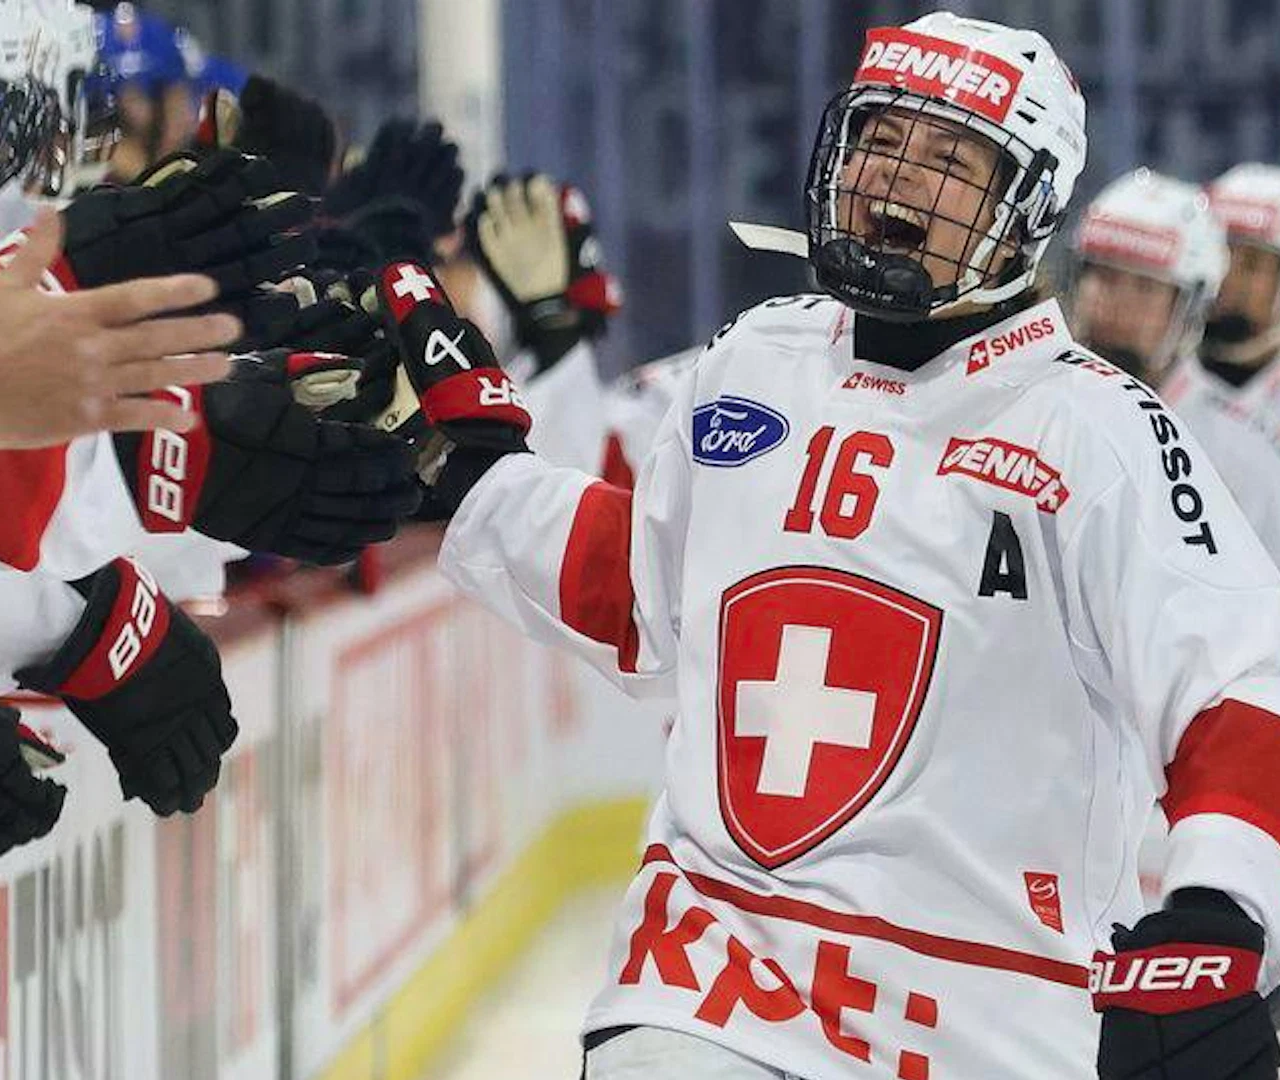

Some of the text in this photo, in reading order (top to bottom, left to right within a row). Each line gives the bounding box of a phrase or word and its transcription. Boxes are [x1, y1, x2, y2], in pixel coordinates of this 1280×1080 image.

[862, 41, 1011, 106] DENNER
[991, 316, 1056, 357] SWISS
[861, 376, 907, 396] SWISS
[782, 425, 896, 540] 16
[1122, 378, 1219, 556] TISSOT
[978, 510, 1029, 601] A
